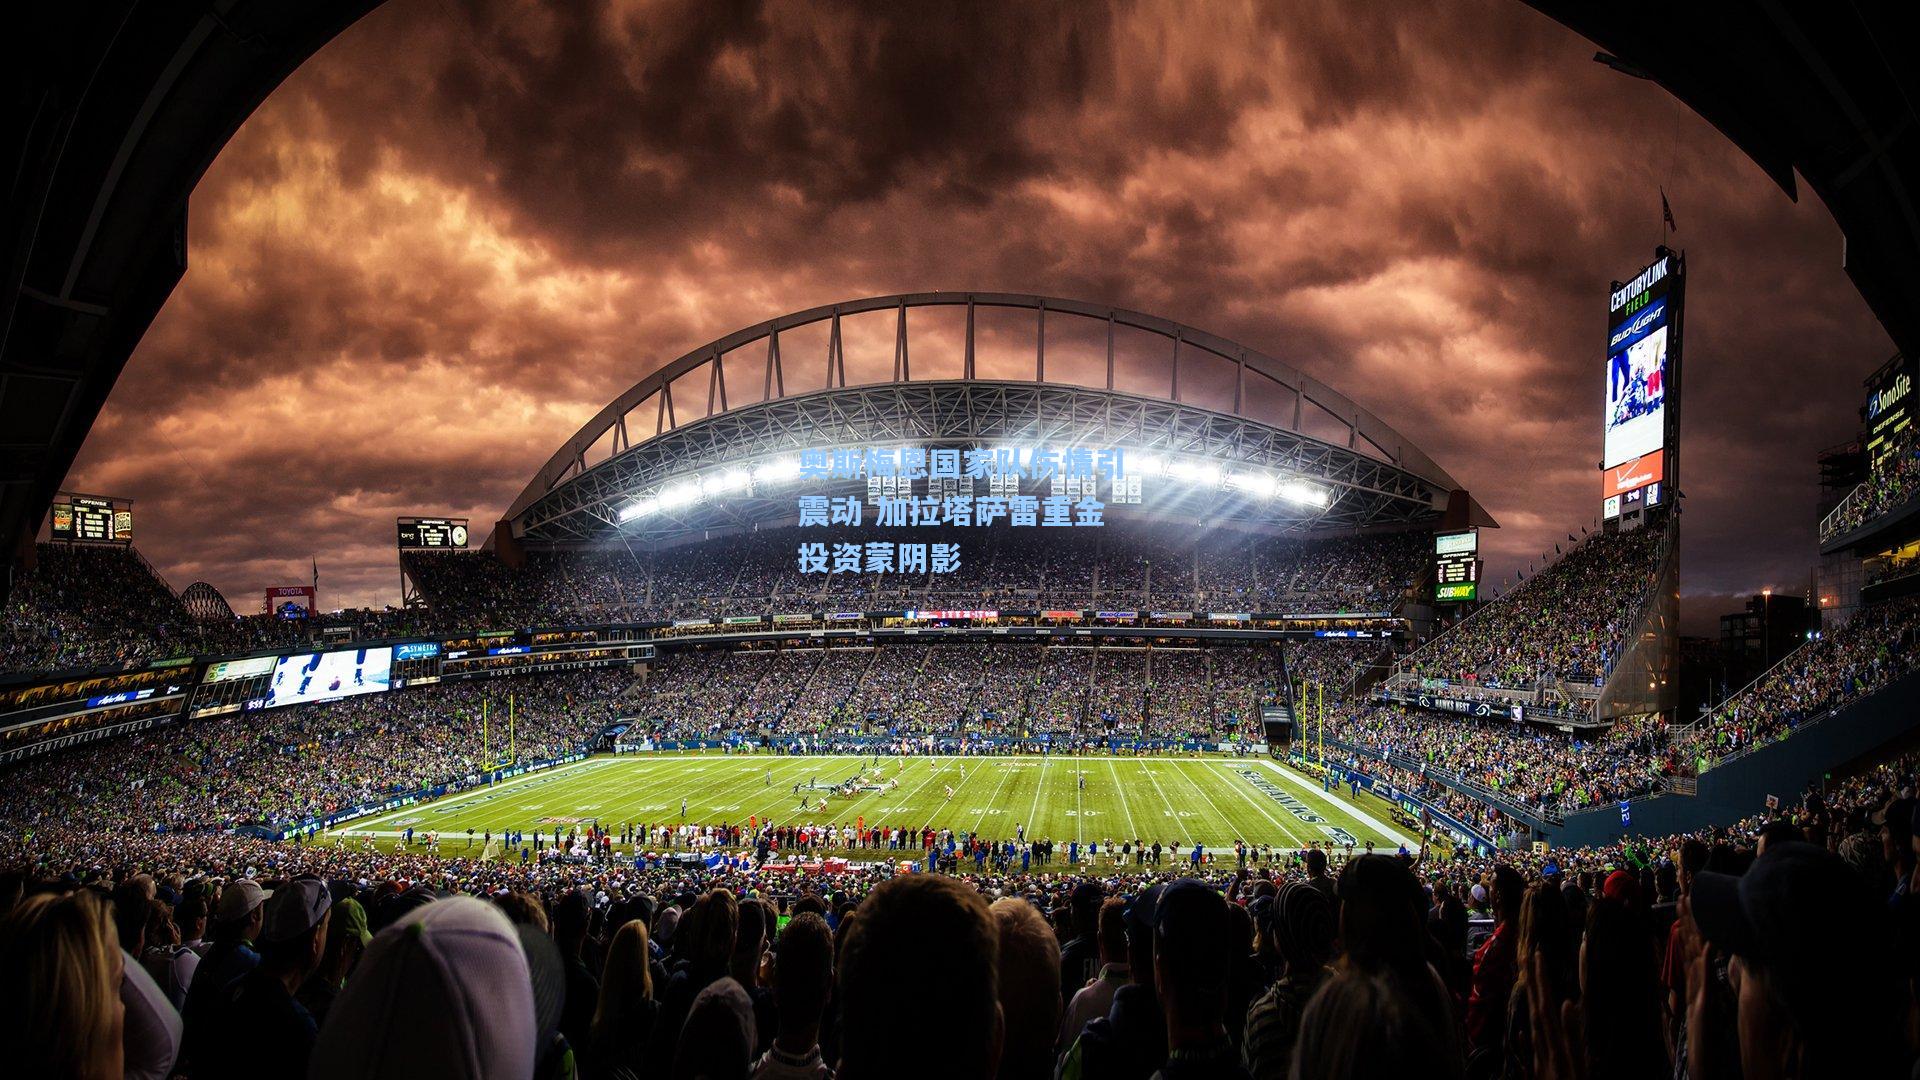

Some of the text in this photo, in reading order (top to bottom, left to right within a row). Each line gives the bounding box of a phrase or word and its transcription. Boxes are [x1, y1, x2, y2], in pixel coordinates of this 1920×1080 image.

[1611, 257, 1668, 312] CENTURYLINK
[1626, 291, 1650, 316] FIELD
[1610, 327, 1632, 346] BUD
[1437, 584, 1475, 598] SUBWAY
[410, 644, 437, 652] SYMETRA
[10, 750, 24, 761] TO
[30, 729, 111, 756] CENTURYLINK
[118, 720, 152, 735] FIELD
[1234, 769, 1328, 823] SEAHAWKS
[1620, 806, 1630, 822] 12
